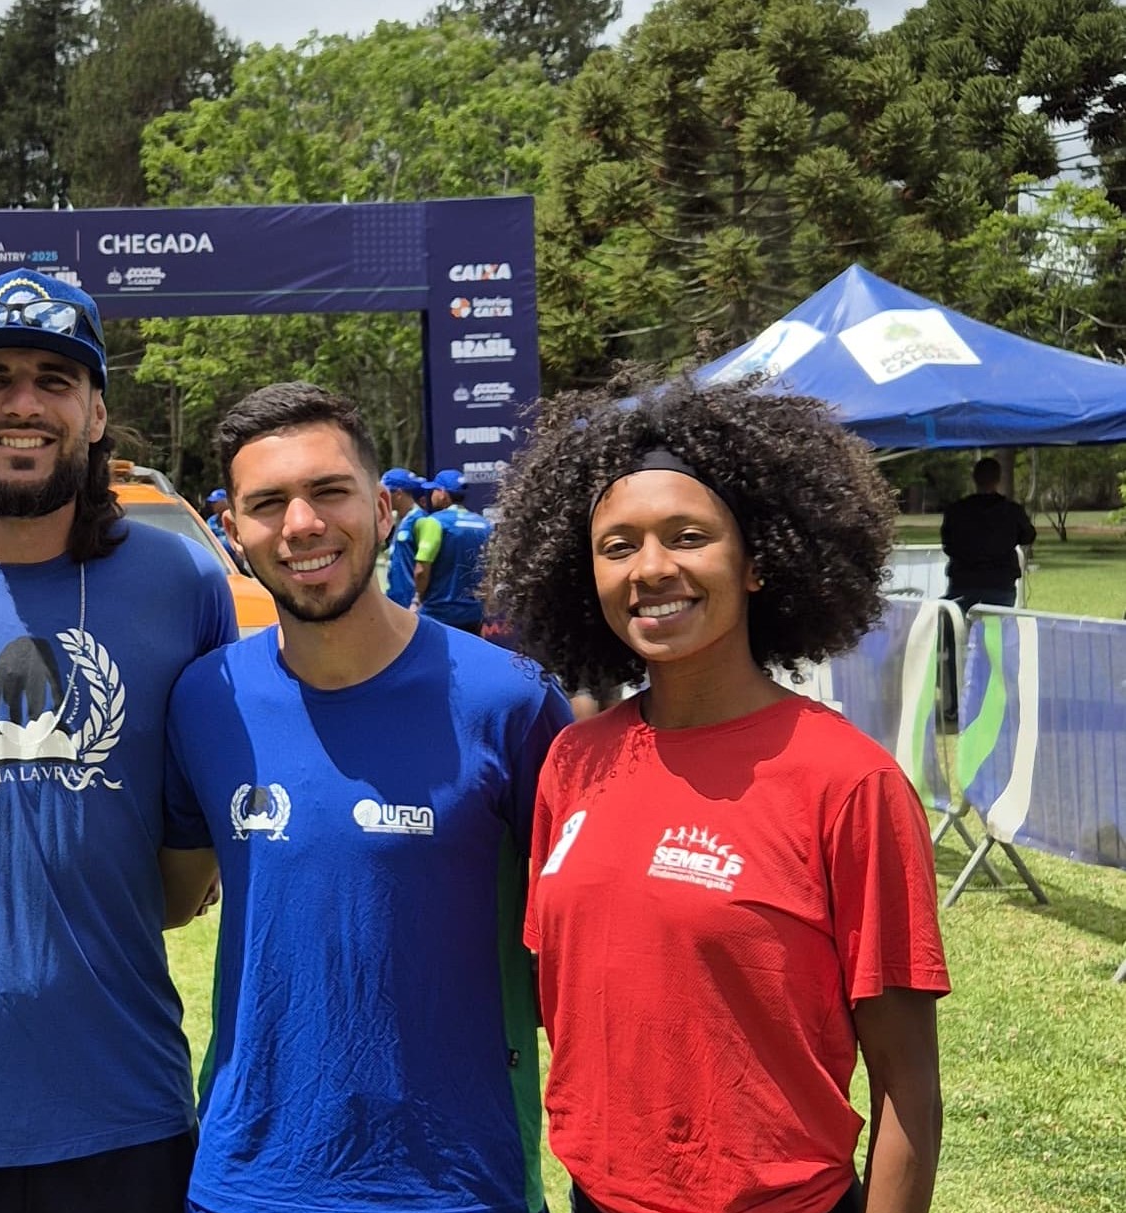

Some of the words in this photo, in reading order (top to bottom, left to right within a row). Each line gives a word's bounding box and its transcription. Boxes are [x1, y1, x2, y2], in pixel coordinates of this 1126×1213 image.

[98, 232, 214, 255] CHEGADA
[31, 251, 58, 262] 2025
[449, 263, 513, 282] CAIXA
[451, 339, 516, 359] BRASIL
[20, 765, 86, 782] LAVRAS
[653, 846, 742, 878] SEMELP
